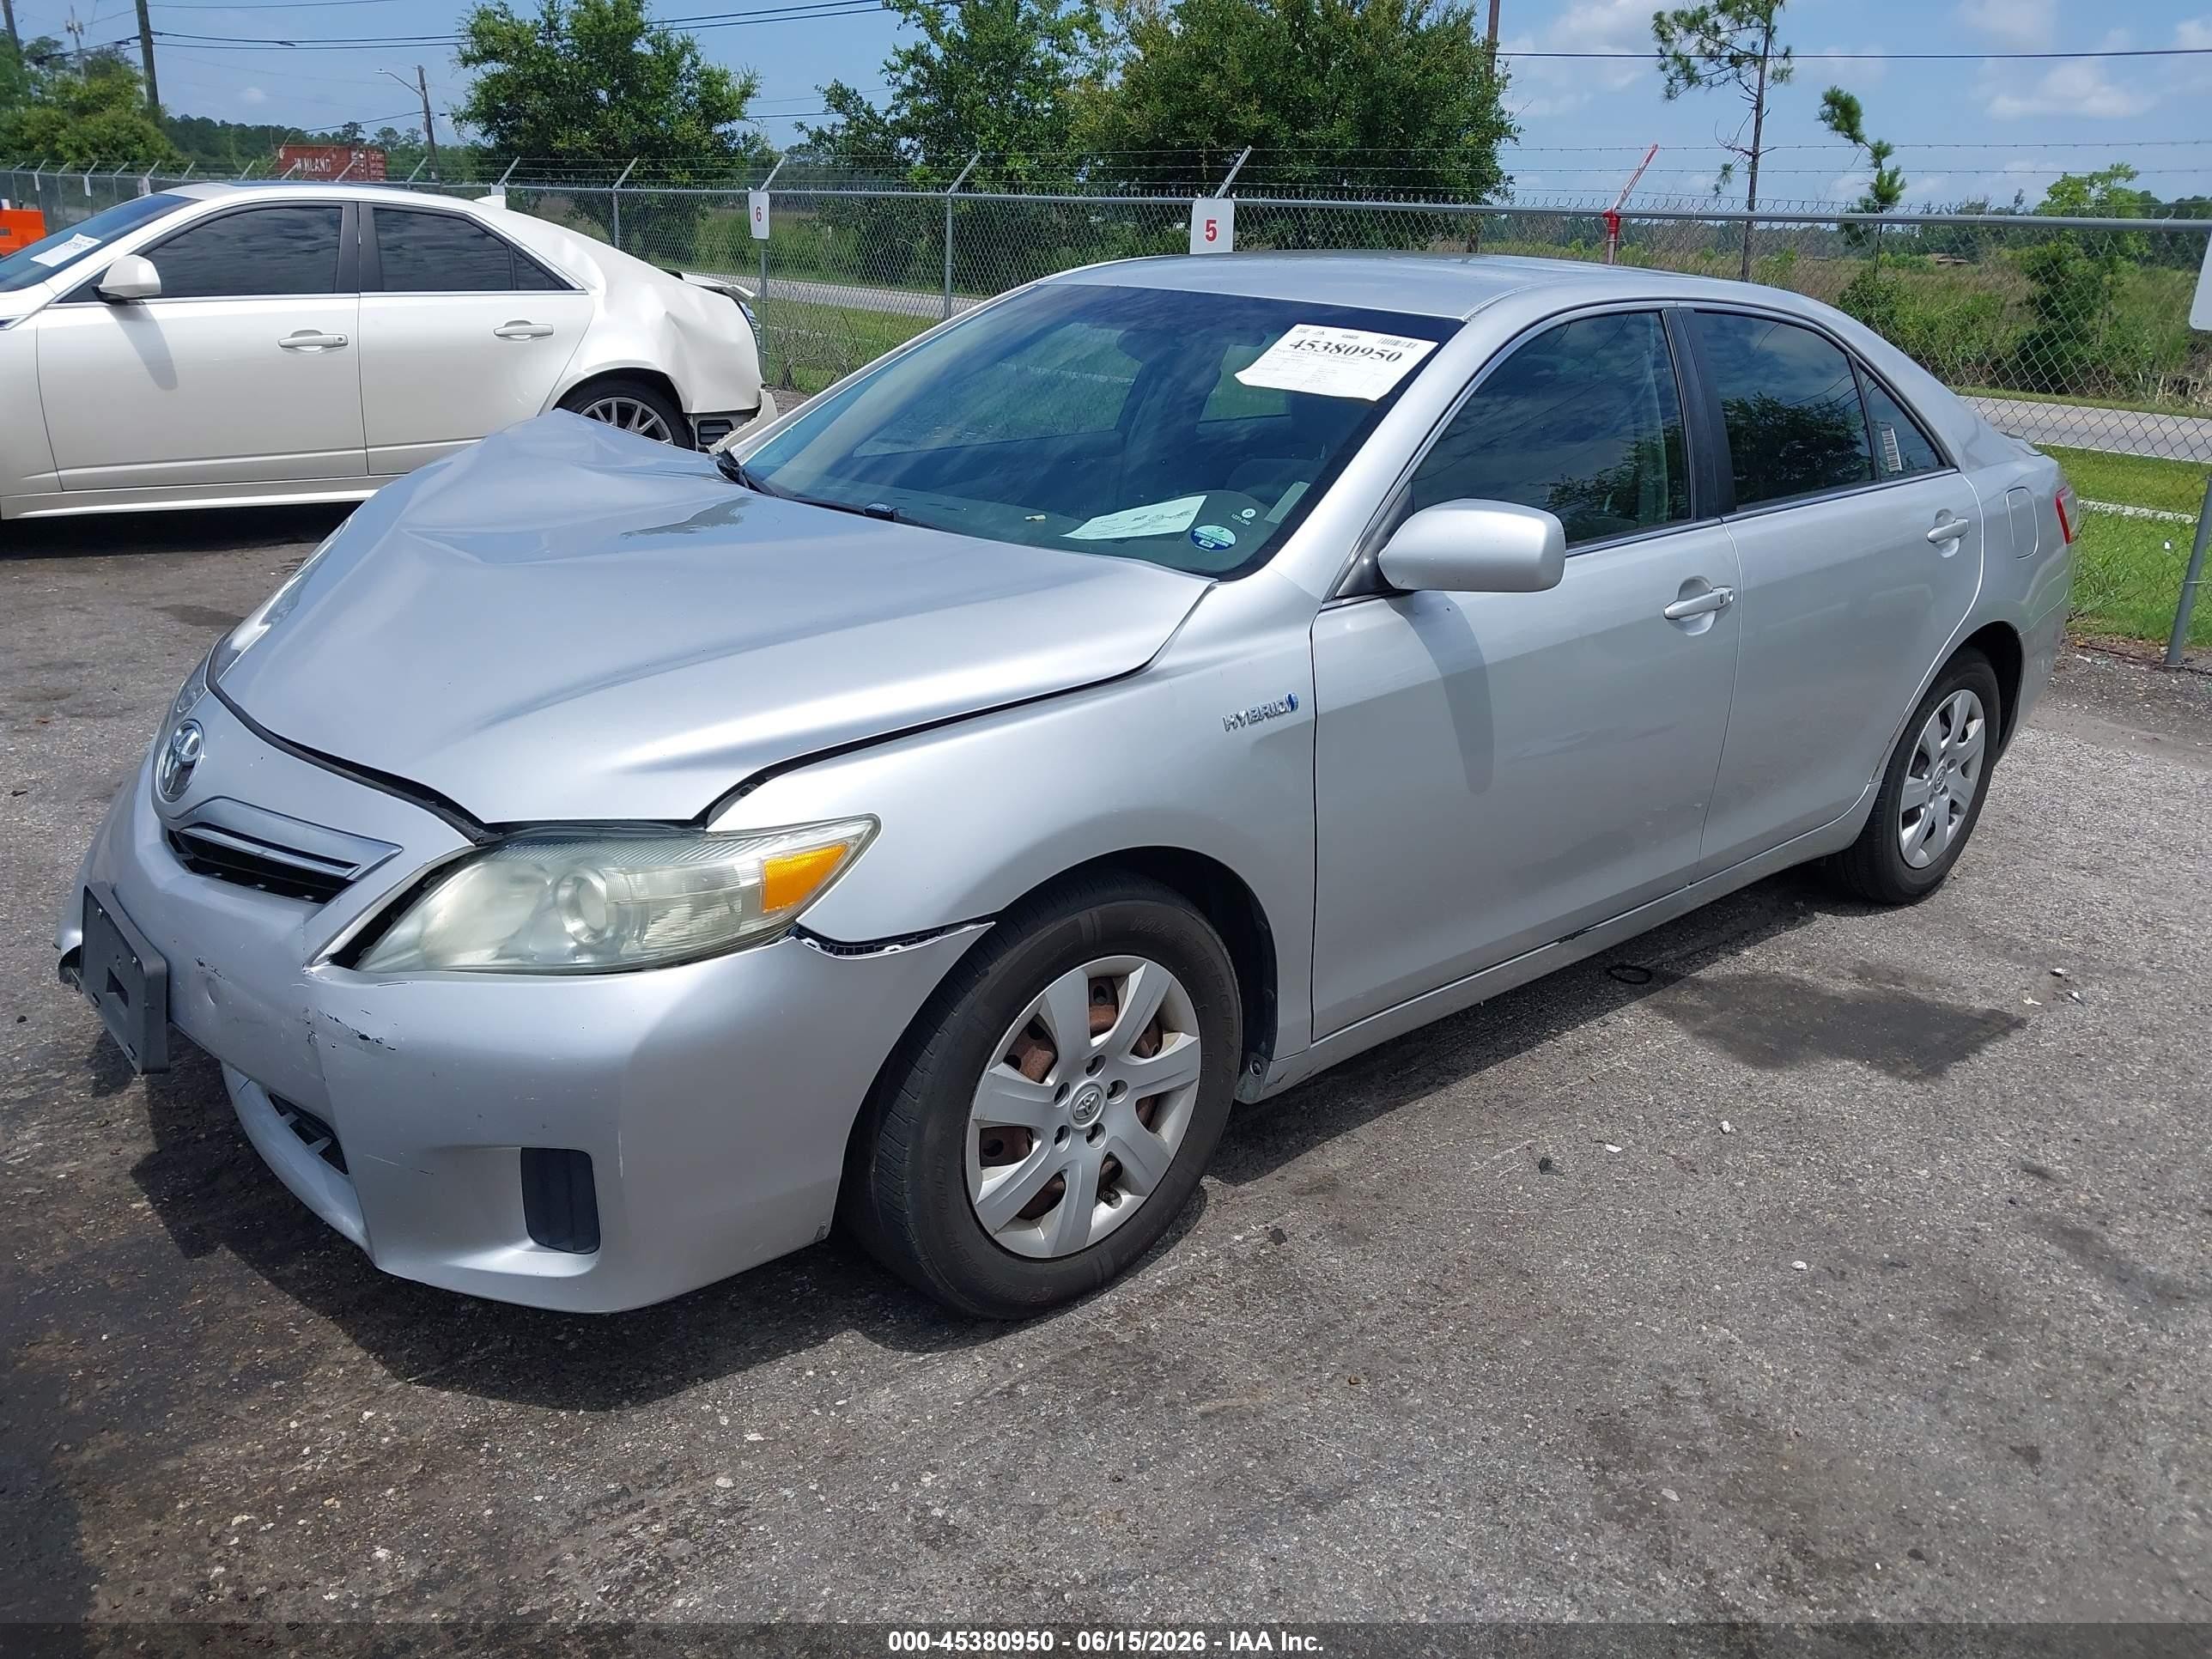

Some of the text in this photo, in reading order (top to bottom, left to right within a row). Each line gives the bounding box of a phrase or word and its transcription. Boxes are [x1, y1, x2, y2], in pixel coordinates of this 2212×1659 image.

[294, 157, 331, 173] WNLAND
[756, 205, 762, 222] 6
[1205, 219, 1218, 242] 5
[1289, 338, 1403, 362] 45380950
[1222, 698, 1289, 732] HYBRID
